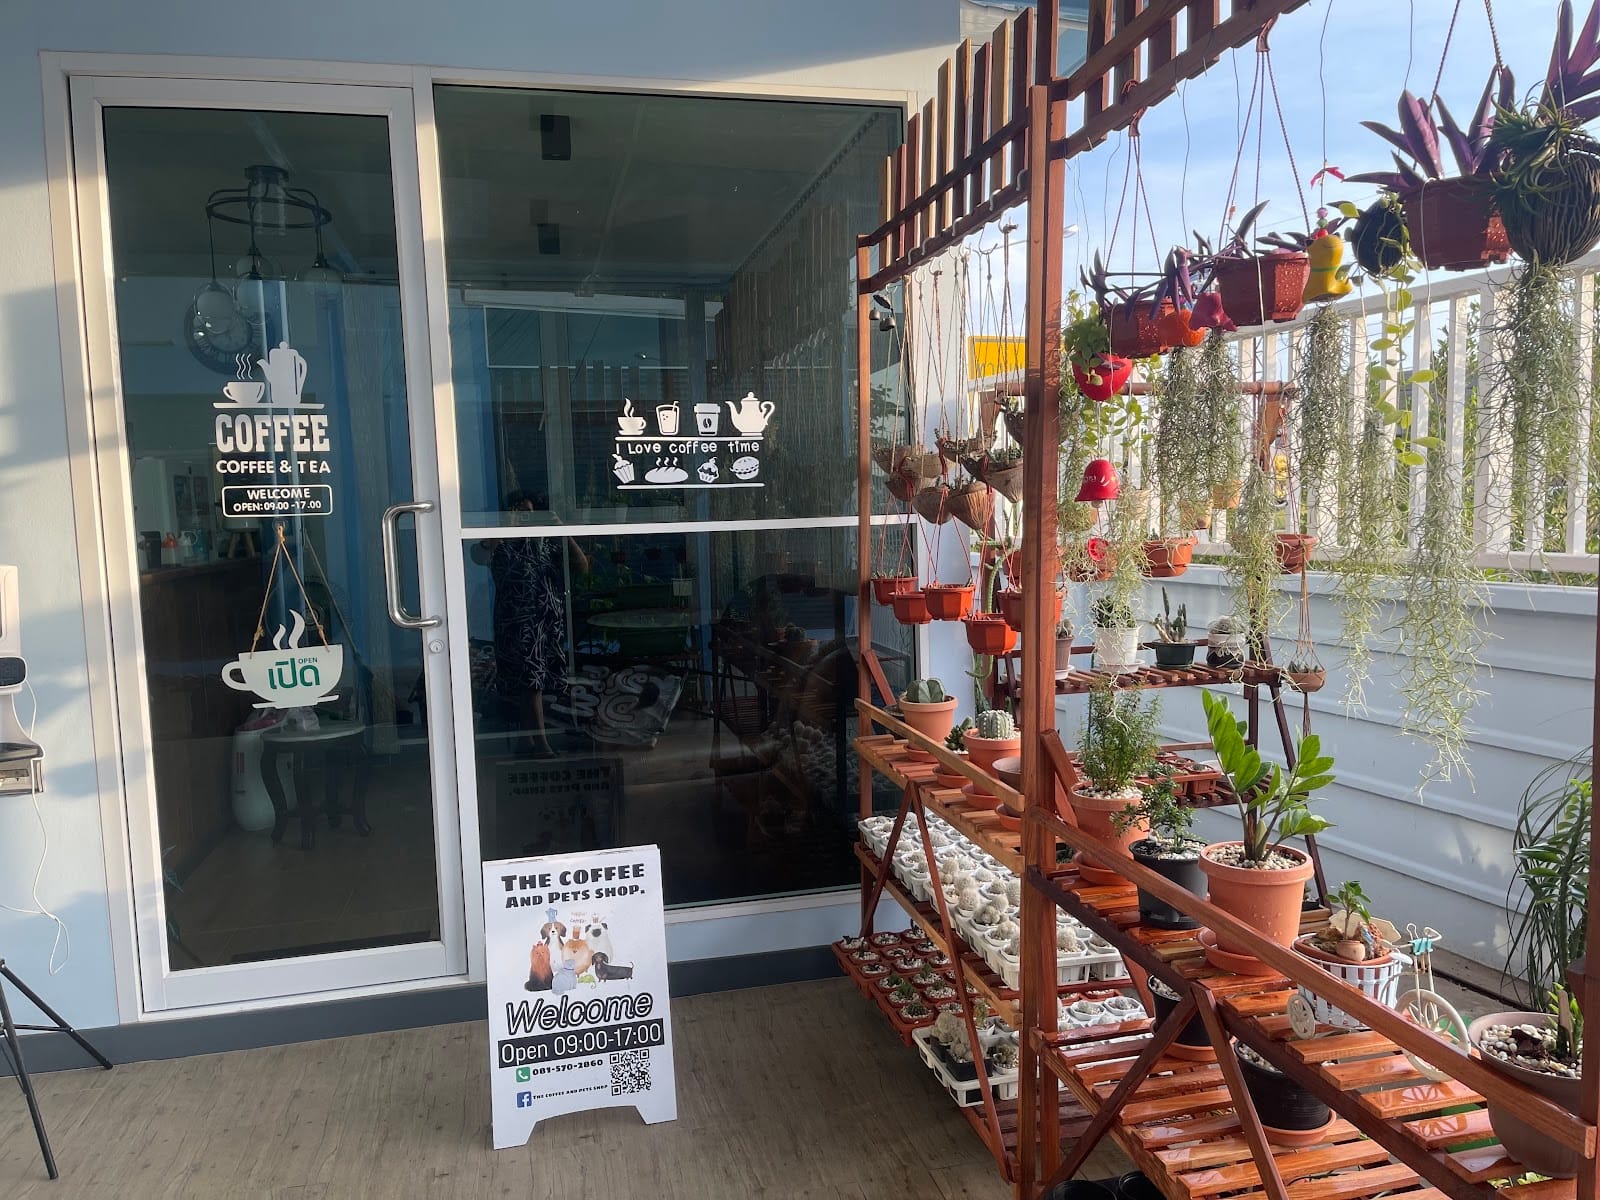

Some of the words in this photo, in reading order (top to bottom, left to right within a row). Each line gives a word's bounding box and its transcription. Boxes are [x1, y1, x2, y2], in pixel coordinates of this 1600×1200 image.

[215, 414, 330, 453] COFFEE
[616, 443, 620, 454] I
[627, 442, 662, 454] Love
[669, 441, 718, 454] coffee
[728, 440, 760, 452] time
[216, 460, 275, 474] COFFEE
[279, 460, 292, 474] &
[297, 460, 331, 474] TEA
[247, 488, 311, 500] WELCOME
[268, 657, 321, 690] เปิด
[501, 873, 551, 892] THE
[559, 863, 645, 886] COFFEE
[505, 894, 543, 909] AND
[548, 889, 590, 904] PETS
[595, 884, 645, 899] SHOP.
[506, 992, 653, 1036] Welcome
[501, 1043, 548, 1065] Open
[554, 1023, 661, 1056] 09:00-17:00
